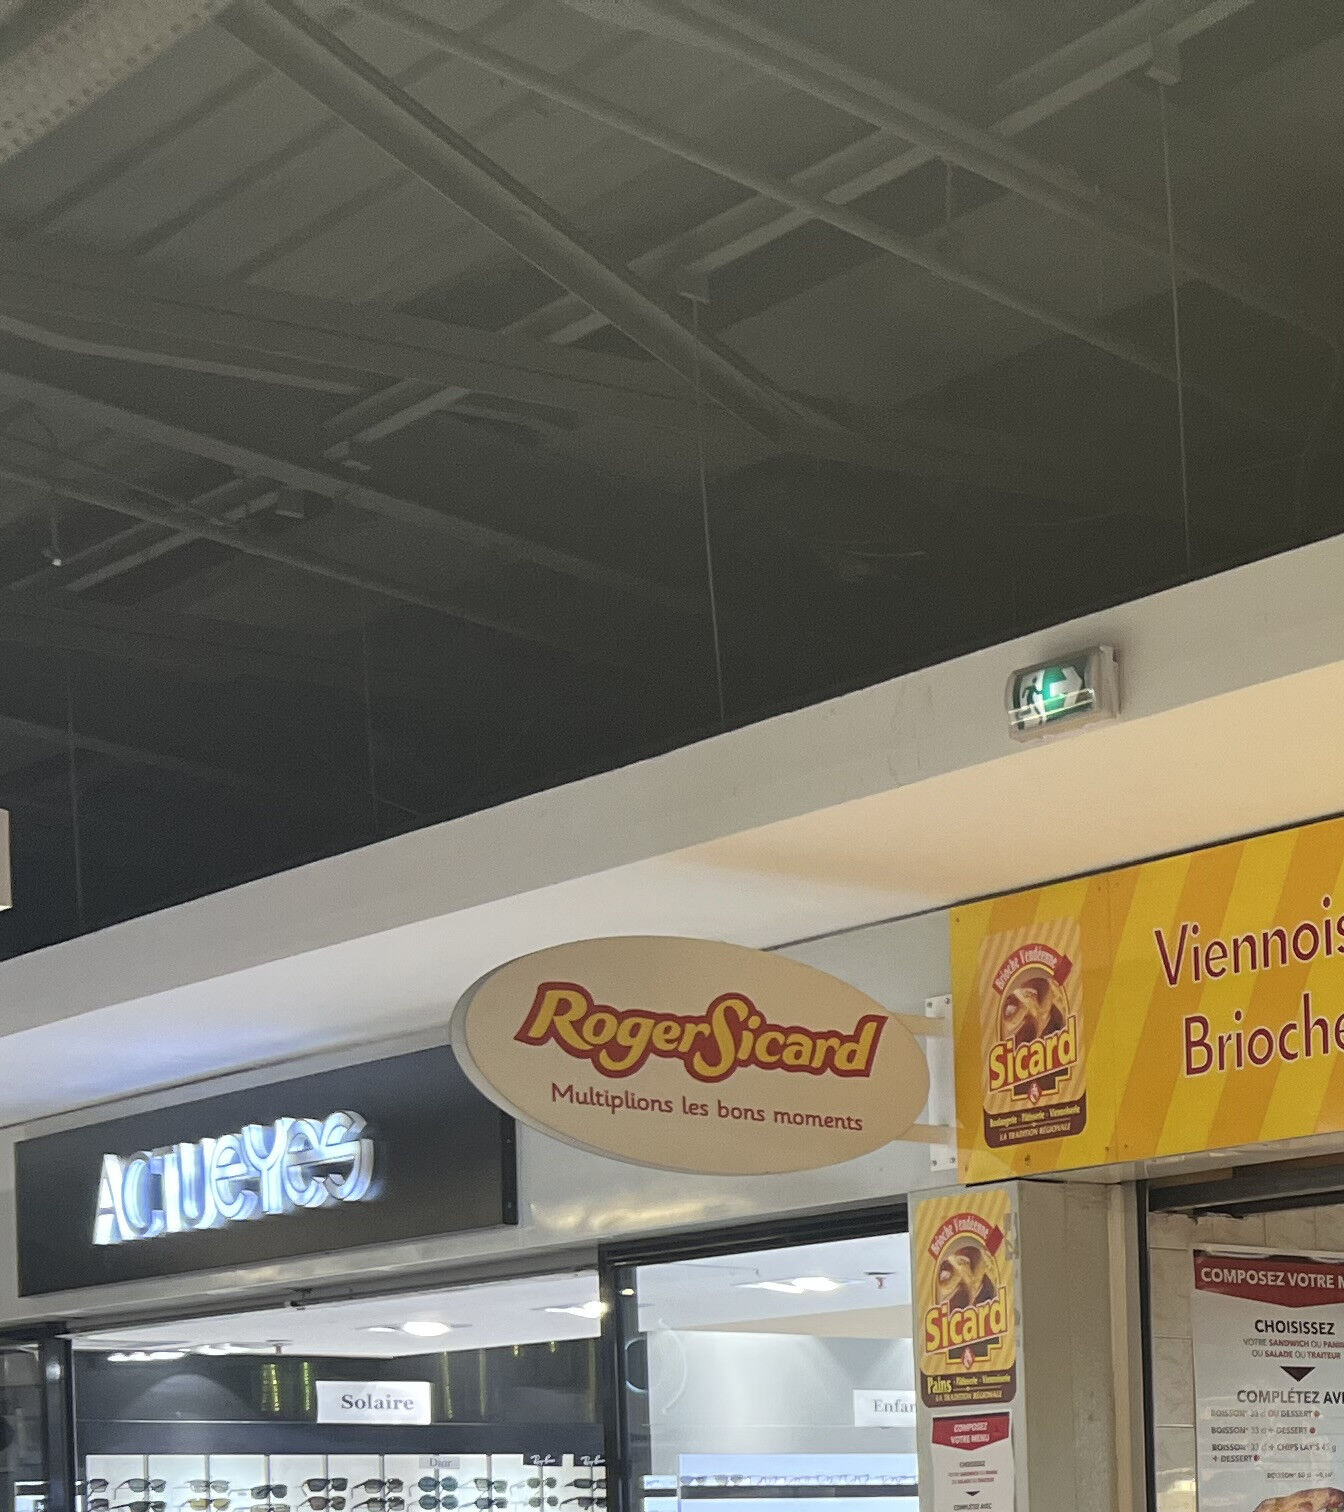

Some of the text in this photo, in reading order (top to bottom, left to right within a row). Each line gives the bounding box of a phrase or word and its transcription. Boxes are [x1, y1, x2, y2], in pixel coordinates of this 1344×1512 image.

[989, 1015, 1077, 1090] Sicard
[551, 1082, 864, 1132] Multiplions les bons moments
[1200, 1267, 1286, 1287] COMPOSEZ
[1287, 1272, 1335, 1289] VOTRE
[924, 1286, 1008, 1353] Sicard
[1254, 1319, 1336, 1336] CHOISISSEZ
[1268, 1339, 1310, 1348] SANDWICH
[1265, 1350, 1293, 1359] SALADE
[927, 1375, 952, 1395] Pains
[340, 1393, 414, 1412] Solaire
[1236, 1387, 1320, 1405] COMPLÉTEZ
